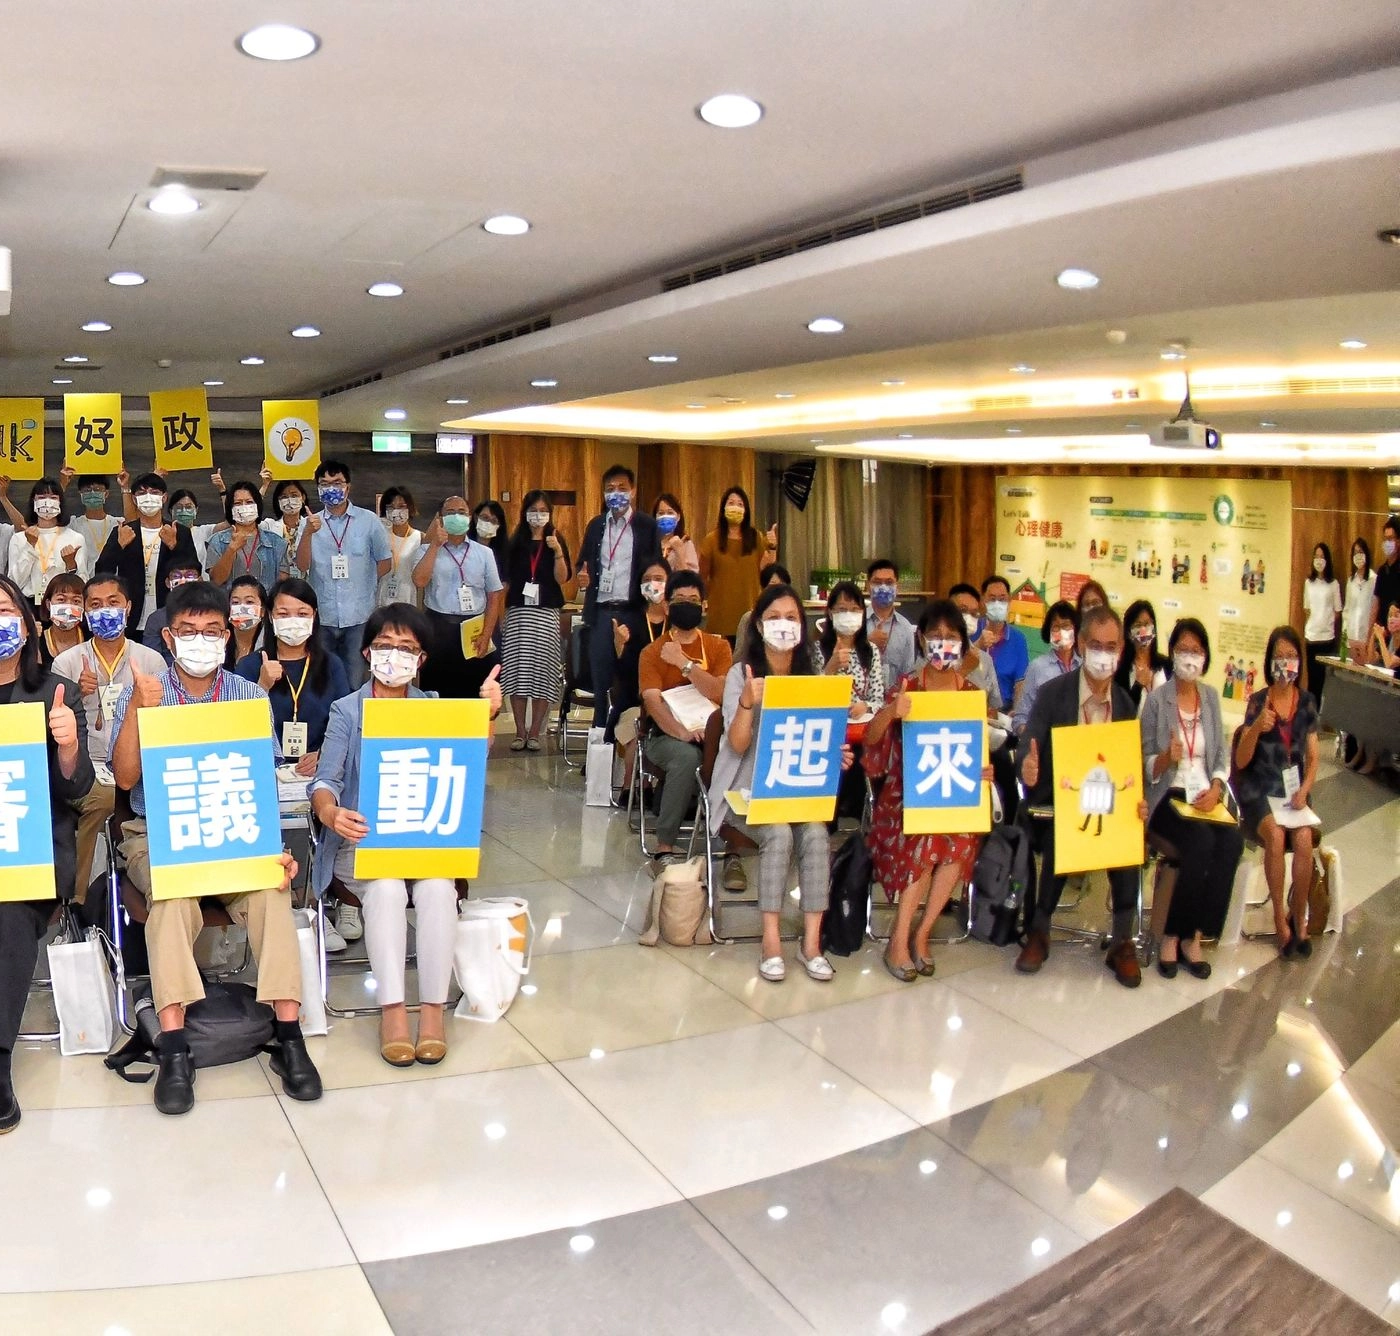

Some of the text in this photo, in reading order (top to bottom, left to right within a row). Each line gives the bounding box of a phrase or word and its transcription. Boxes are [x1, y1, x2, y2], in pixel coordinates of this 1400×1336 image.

[74, 416, 115, 456] 好
[161, 412, 204, 452] 政
[1015, 519, 1064, 539] 心理健康
[765, 716, 832, 789] 起
[915, 727, 976, 798] 來
[163, 752, 260, 852] 議
[377, 747, 467, 836] 動
